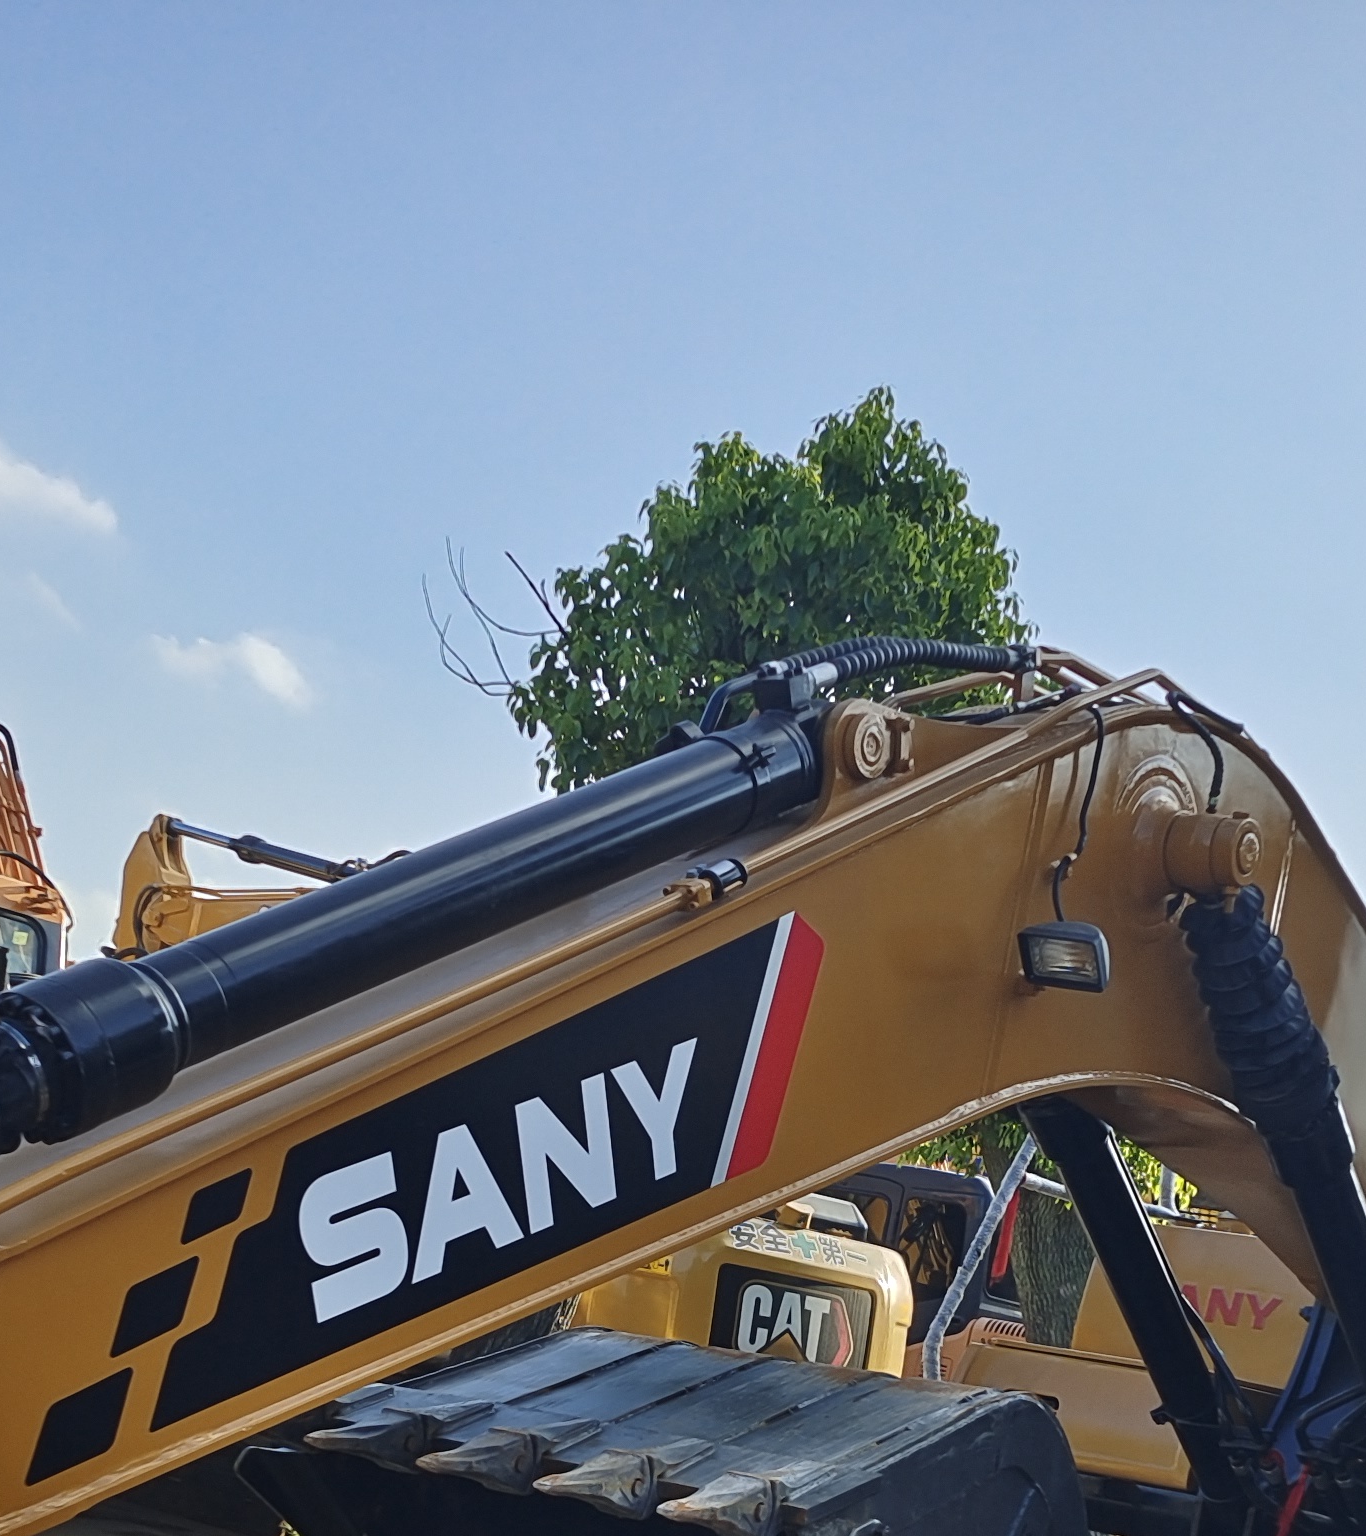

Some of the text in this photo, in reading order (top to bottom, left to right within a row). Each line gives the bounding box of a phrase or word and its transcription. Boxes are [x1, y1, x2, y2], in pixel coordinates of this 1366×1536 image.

[299, 1037, 698, 1323] SANY
[730, 1222, 867, 1265] 安全 第一
[737, 1285, 831, 1363] CAT
